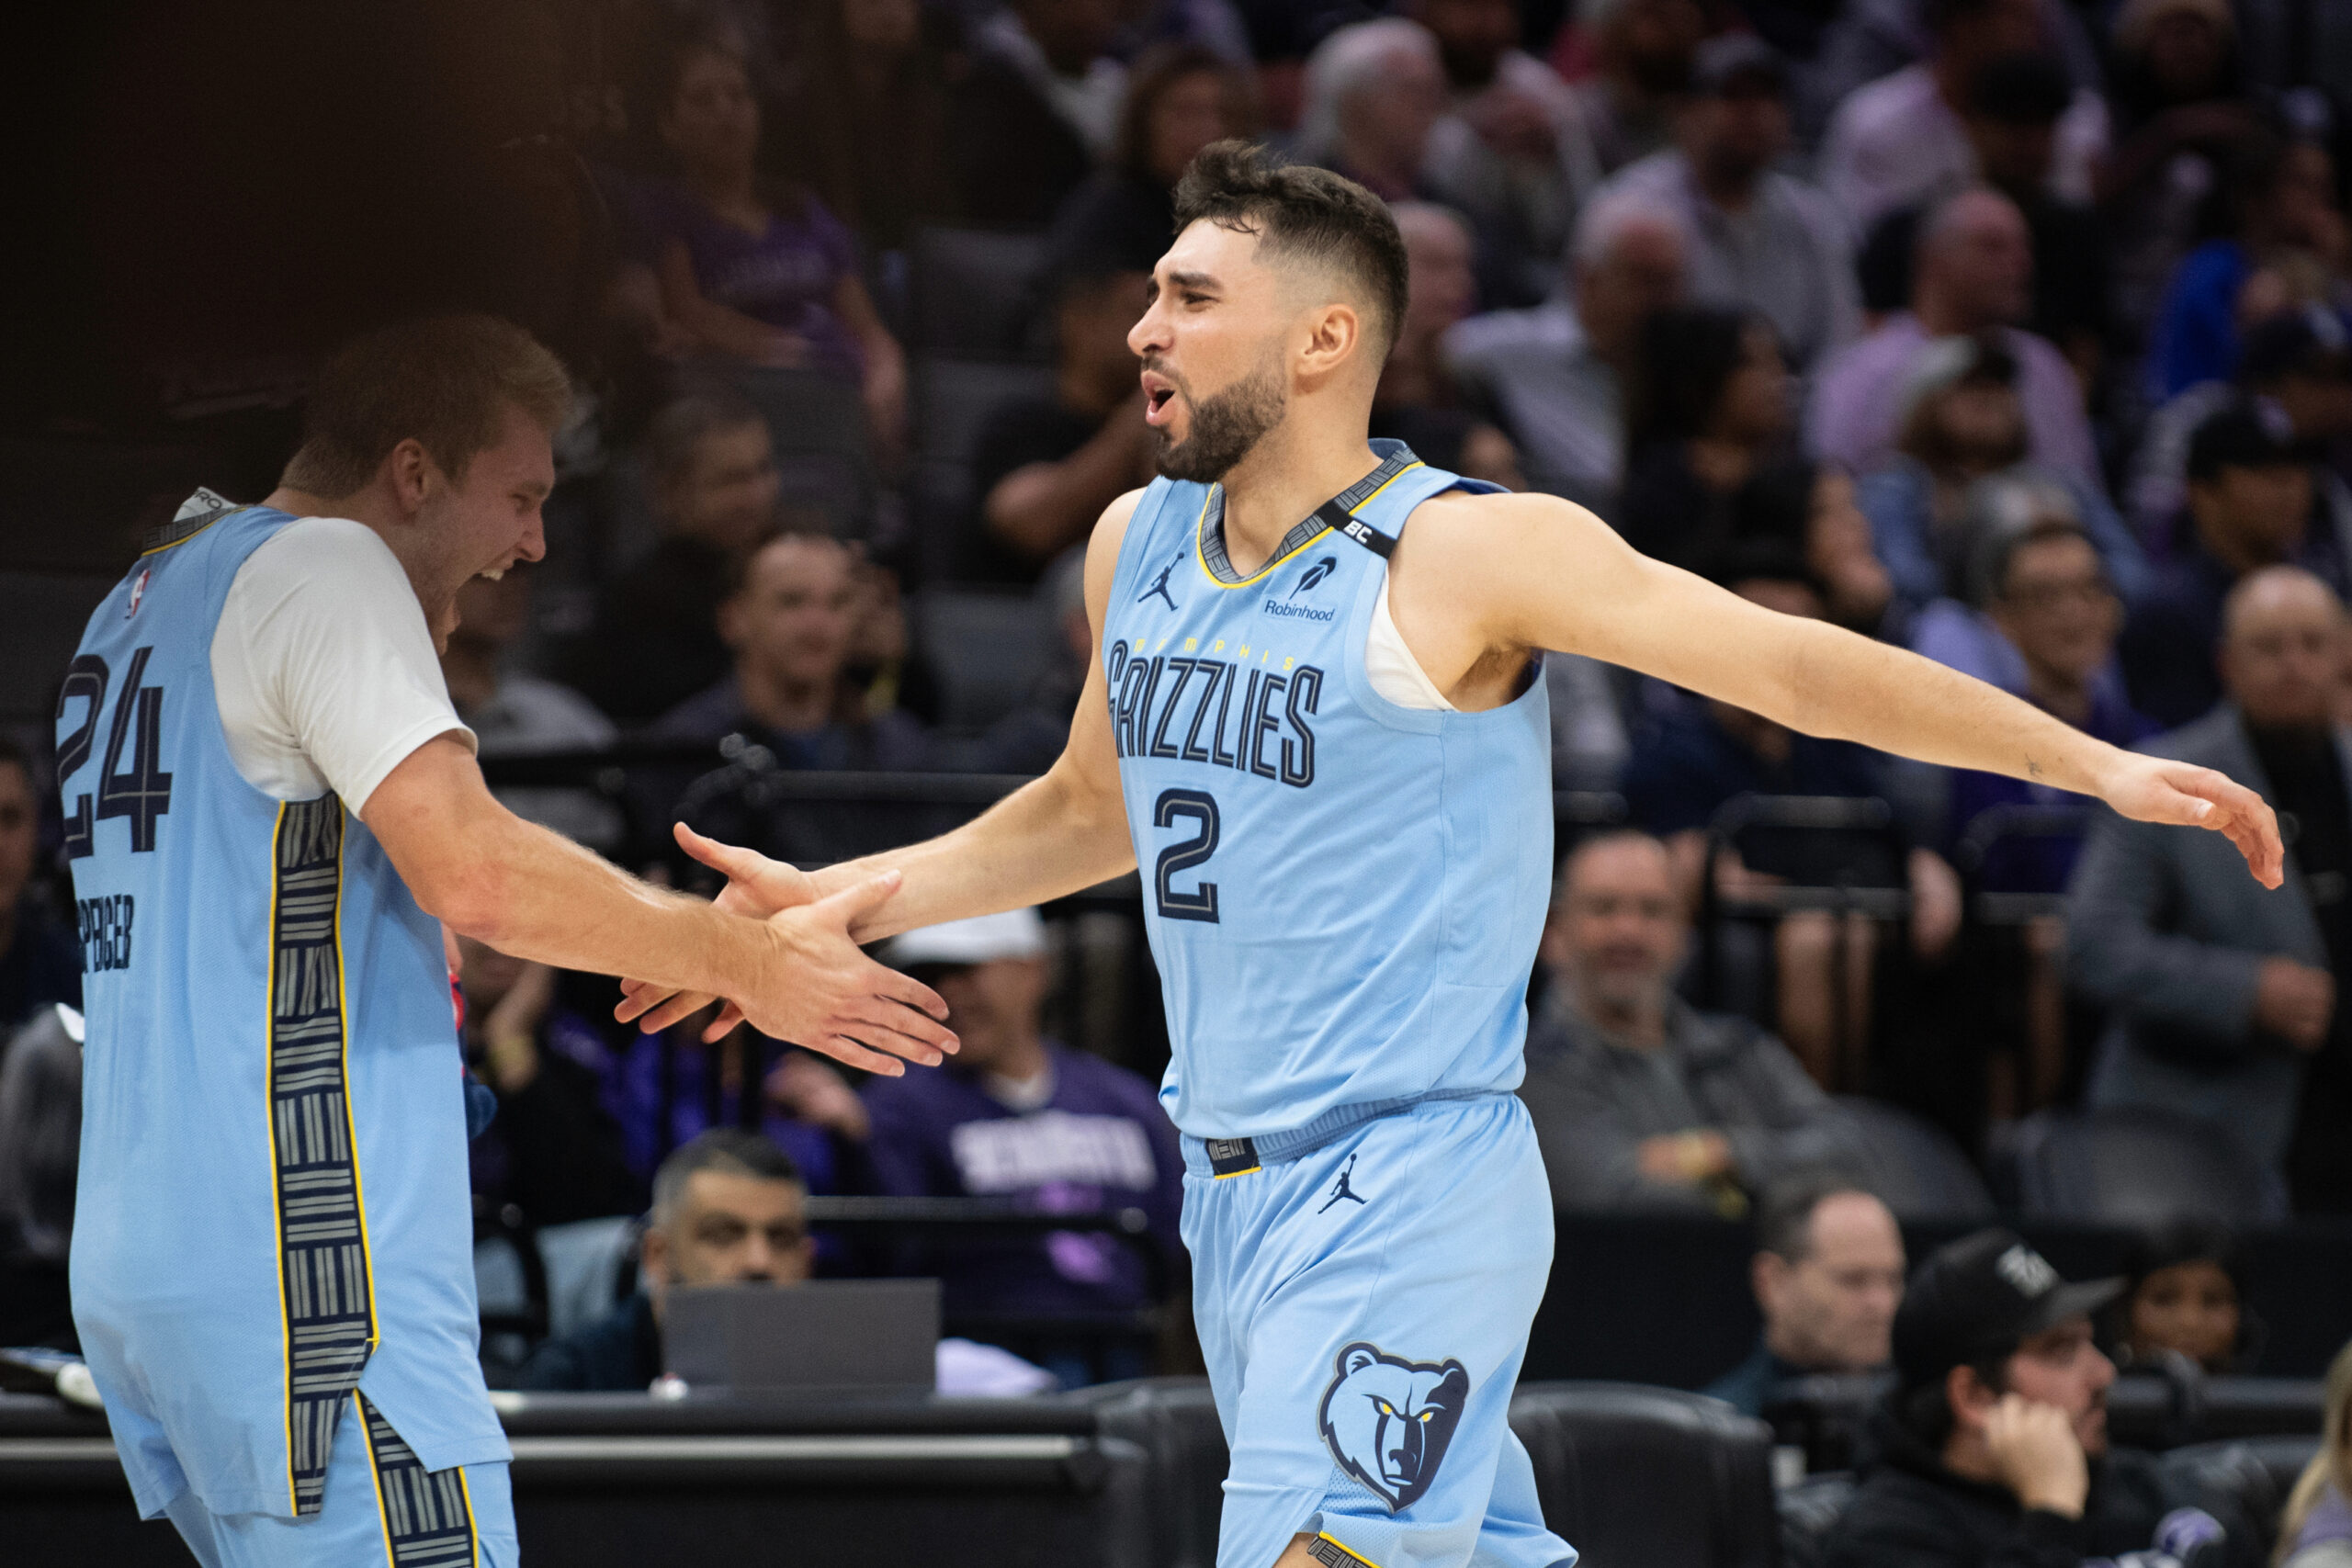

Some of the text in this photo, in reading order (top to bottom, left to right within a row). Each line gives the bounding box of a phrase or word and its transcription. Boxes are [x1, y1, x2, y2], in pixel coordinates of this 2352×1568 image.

[1343, 520, 1373, 544] BC
[1264, 599, 1336, 622] Robinhood
[55, 646, 173, 861] 24
[1106, 638, 1325, 789] GRIZZLIES
[1154, 787, 1220, 925] 2
